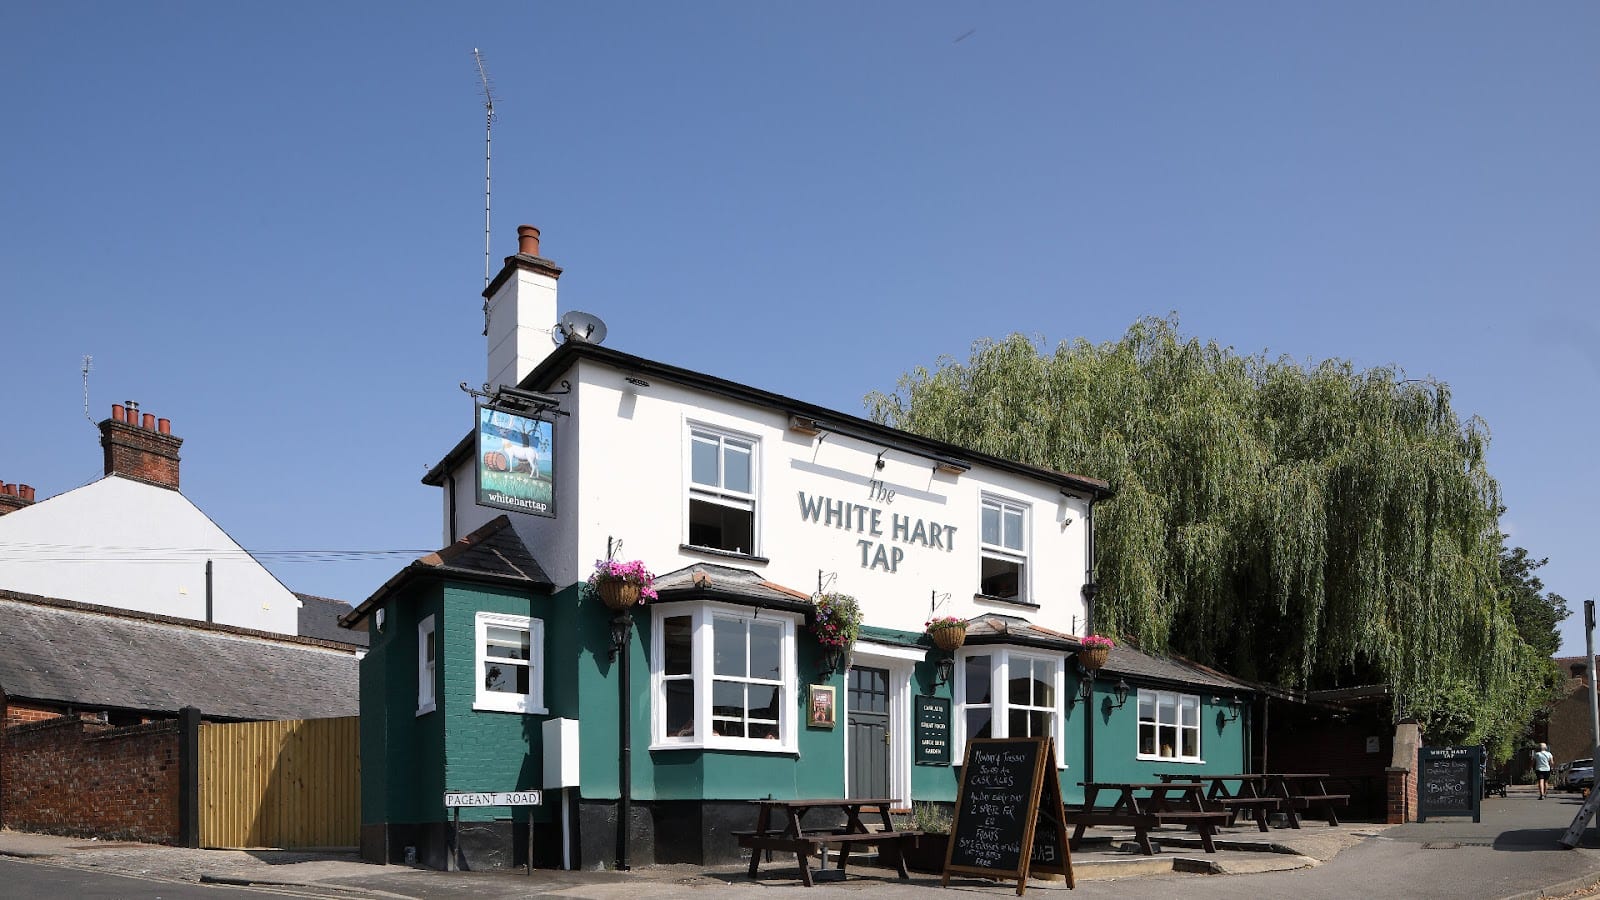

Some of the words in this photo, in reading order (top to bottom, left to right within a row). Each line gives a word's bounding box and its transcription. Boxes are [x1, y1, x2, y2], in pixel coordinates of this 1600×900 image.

[868, 479, 896, 505] The
[798, 490, 883, 538] WHITE
[891, 512, 958, 552] HART
[857, 538, 904, 574] TAP
[448, 793, 497, 805] PAGEANT
[506, 793, 537, 804] ROAD
